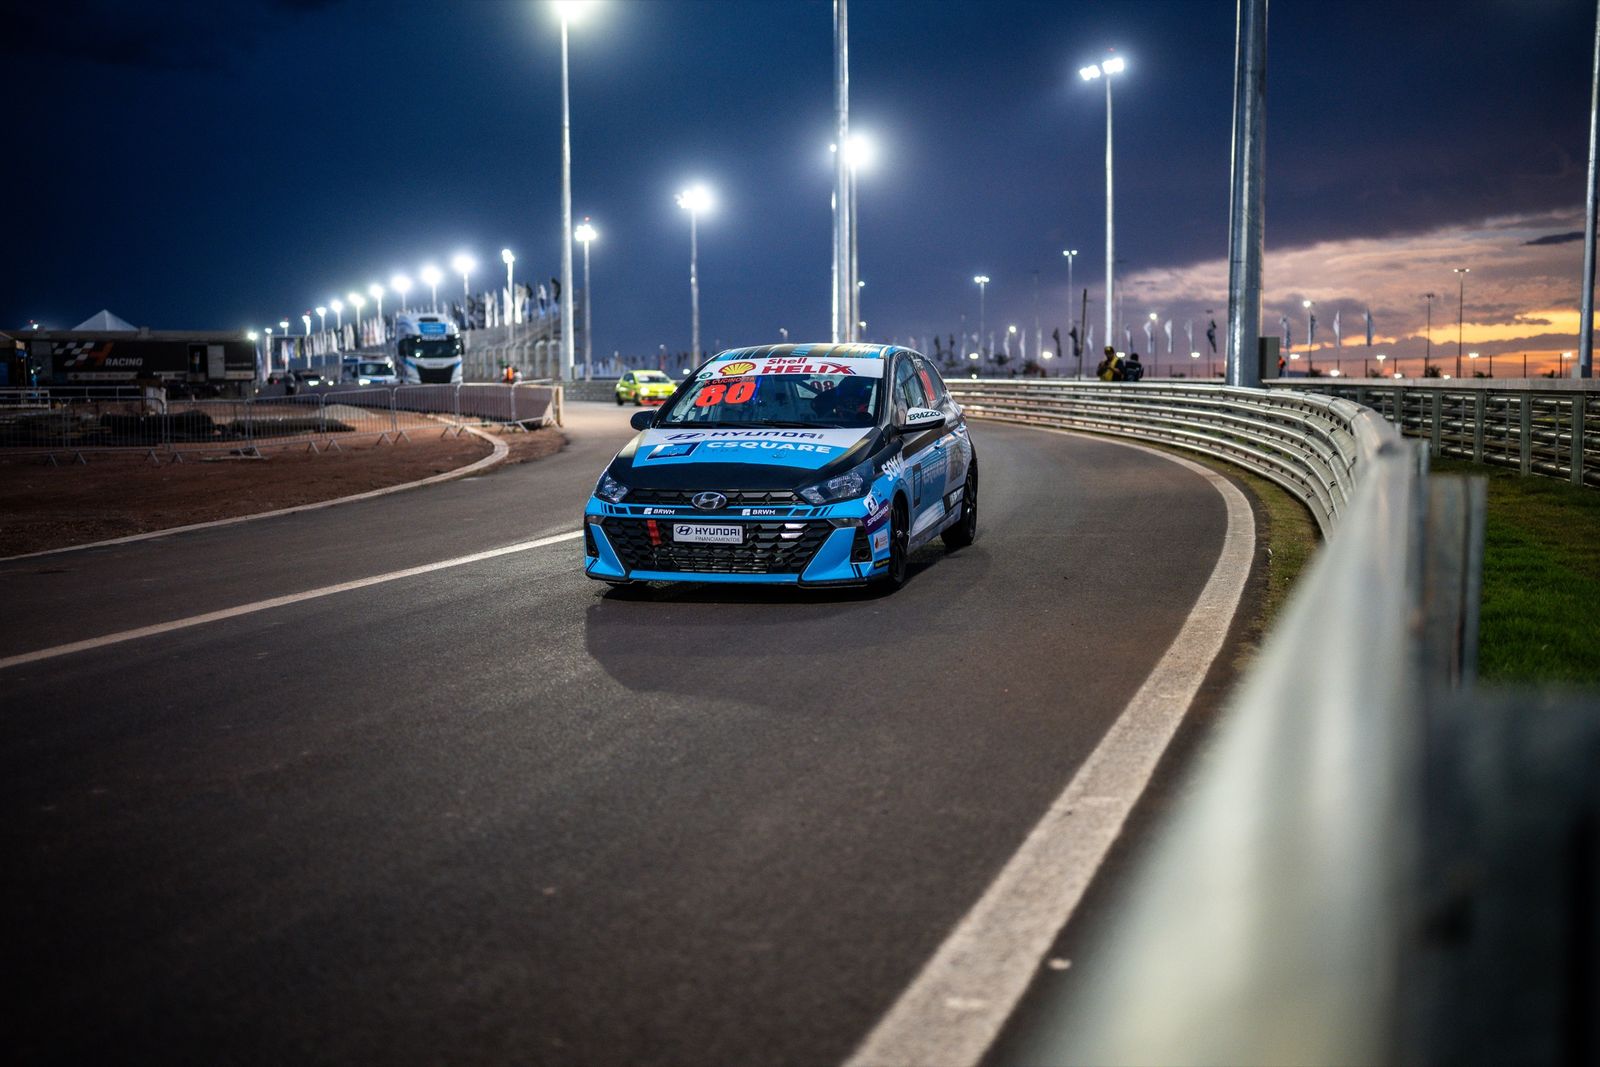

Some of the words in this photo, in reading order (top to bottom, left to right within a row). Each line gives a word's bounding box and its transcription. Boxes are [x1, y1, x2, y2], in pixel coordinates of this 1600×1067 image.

[104, 357, 144, 367] RACING
[767, 357, 808, 365] Shell
[761, 361, 856, 375] HELIX
[695, 381, 757, 407] 80
[907, 411, 941, 421] BRAZZO
[711, 431, 824, 440] HYUNDAI
[706, 441, 832, 454] CSQUARE
[695, 527, 740, 536] HYUNDAI
